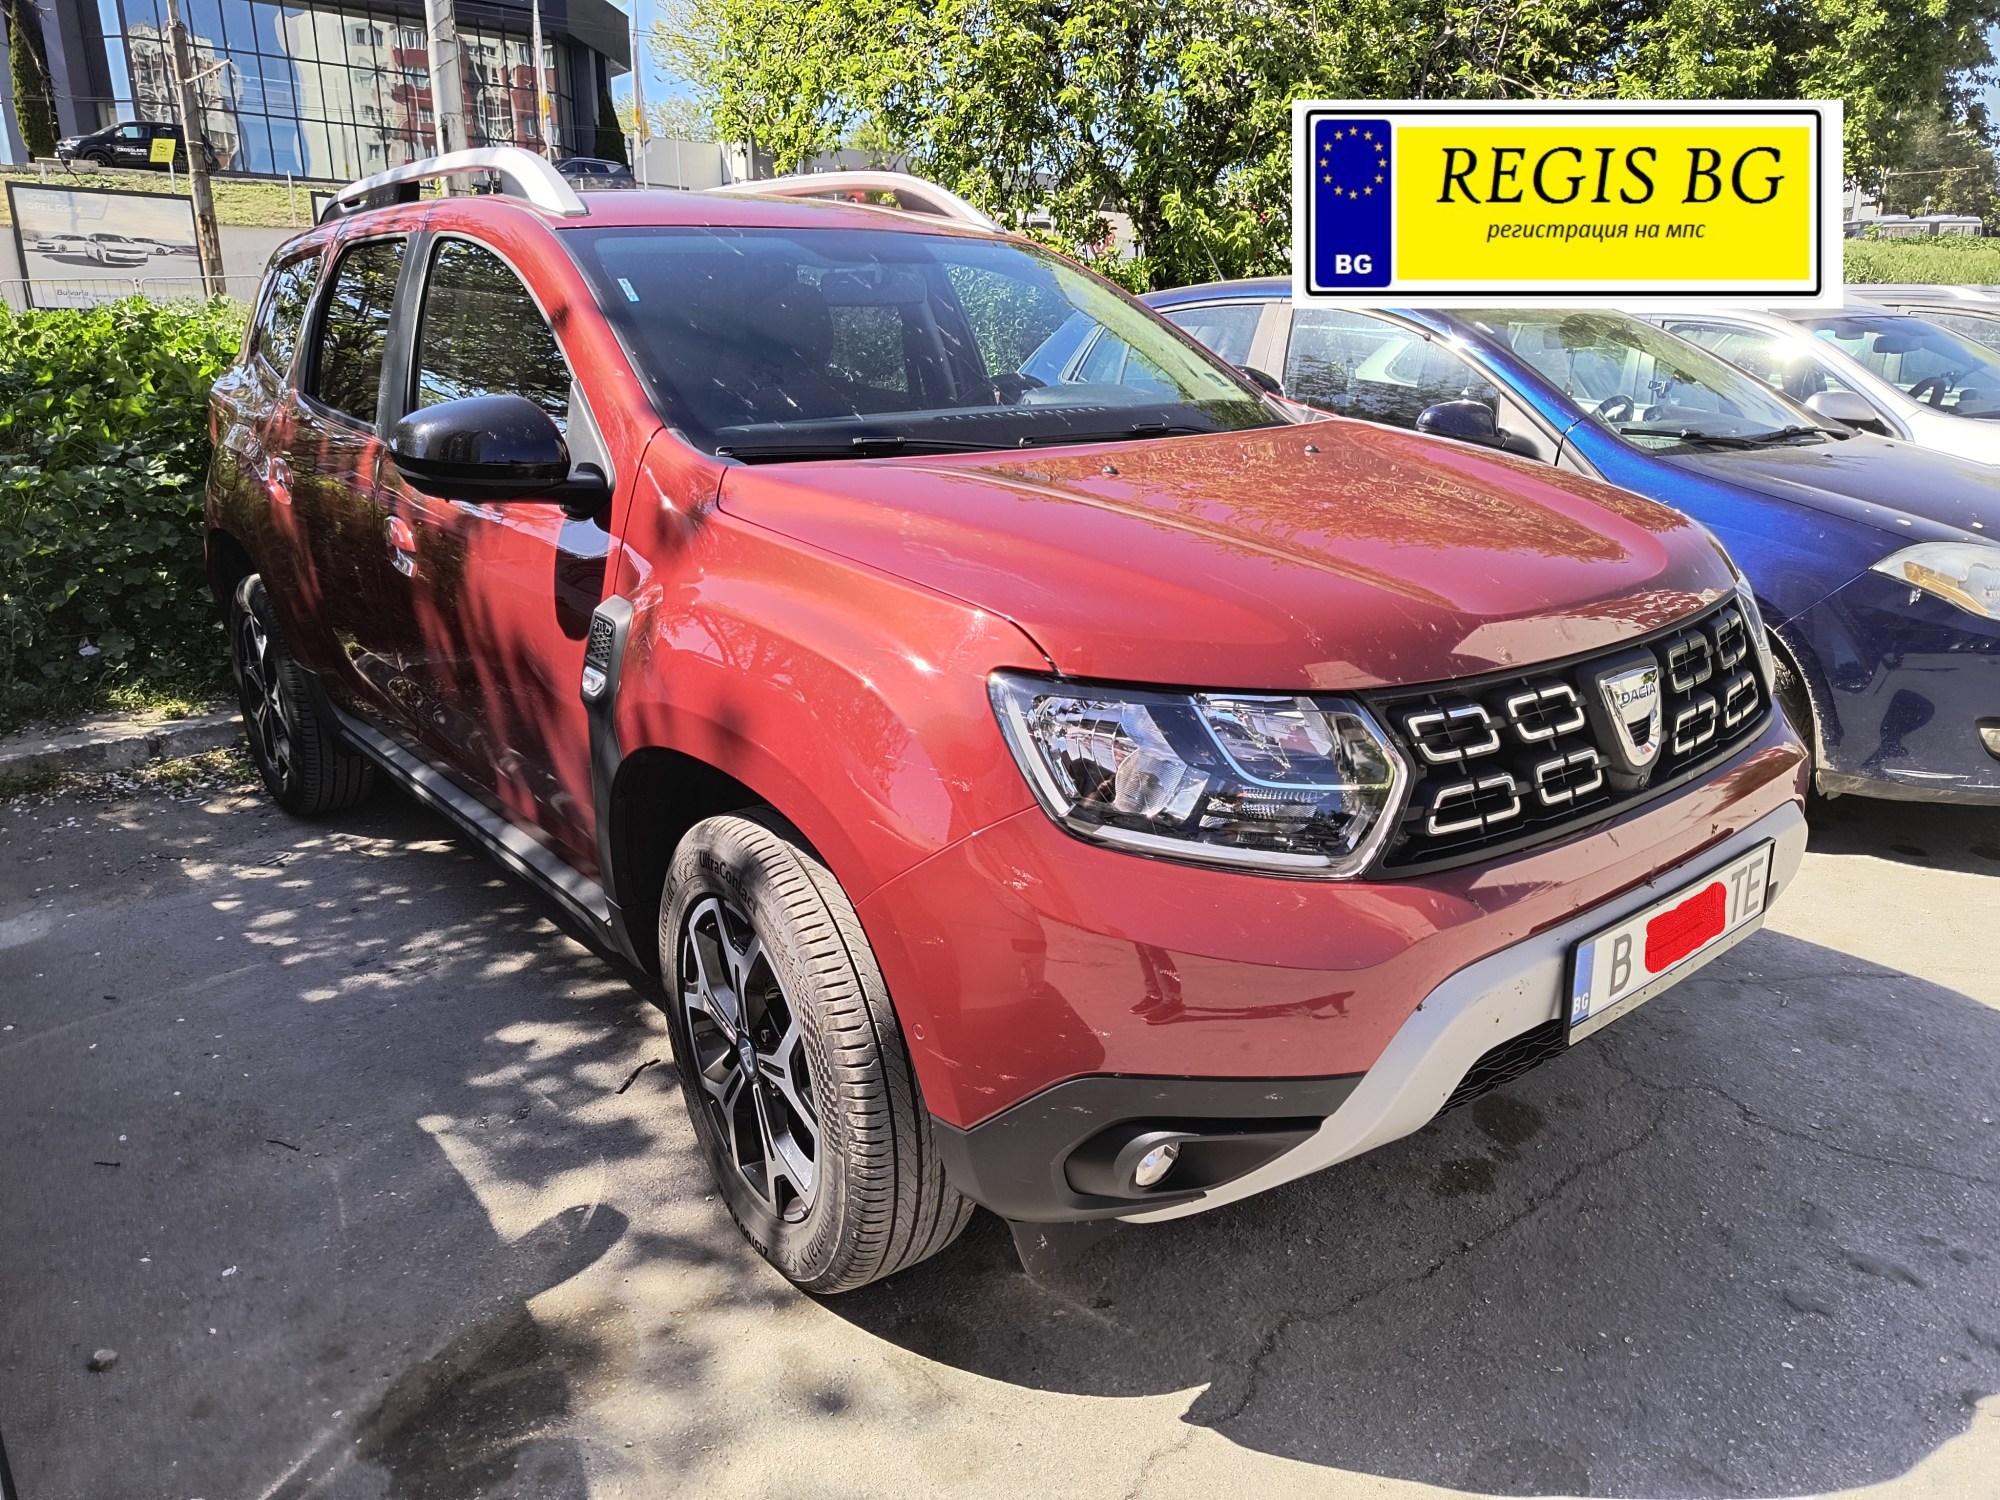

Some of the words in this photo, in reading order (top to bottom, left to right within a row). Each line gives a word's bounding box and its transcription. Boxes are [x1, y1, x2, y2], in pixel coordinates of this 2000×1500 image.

[25, 201, 54, 212] OPEL
[1620, 683, 1657, 708] DACIA
[698, 850, 758, 917] UltraContact
[1609, 933, 1632, 997] B
[1731, 857, 1764, 924] TE
[1573, 993, 1589, 1015] BG
